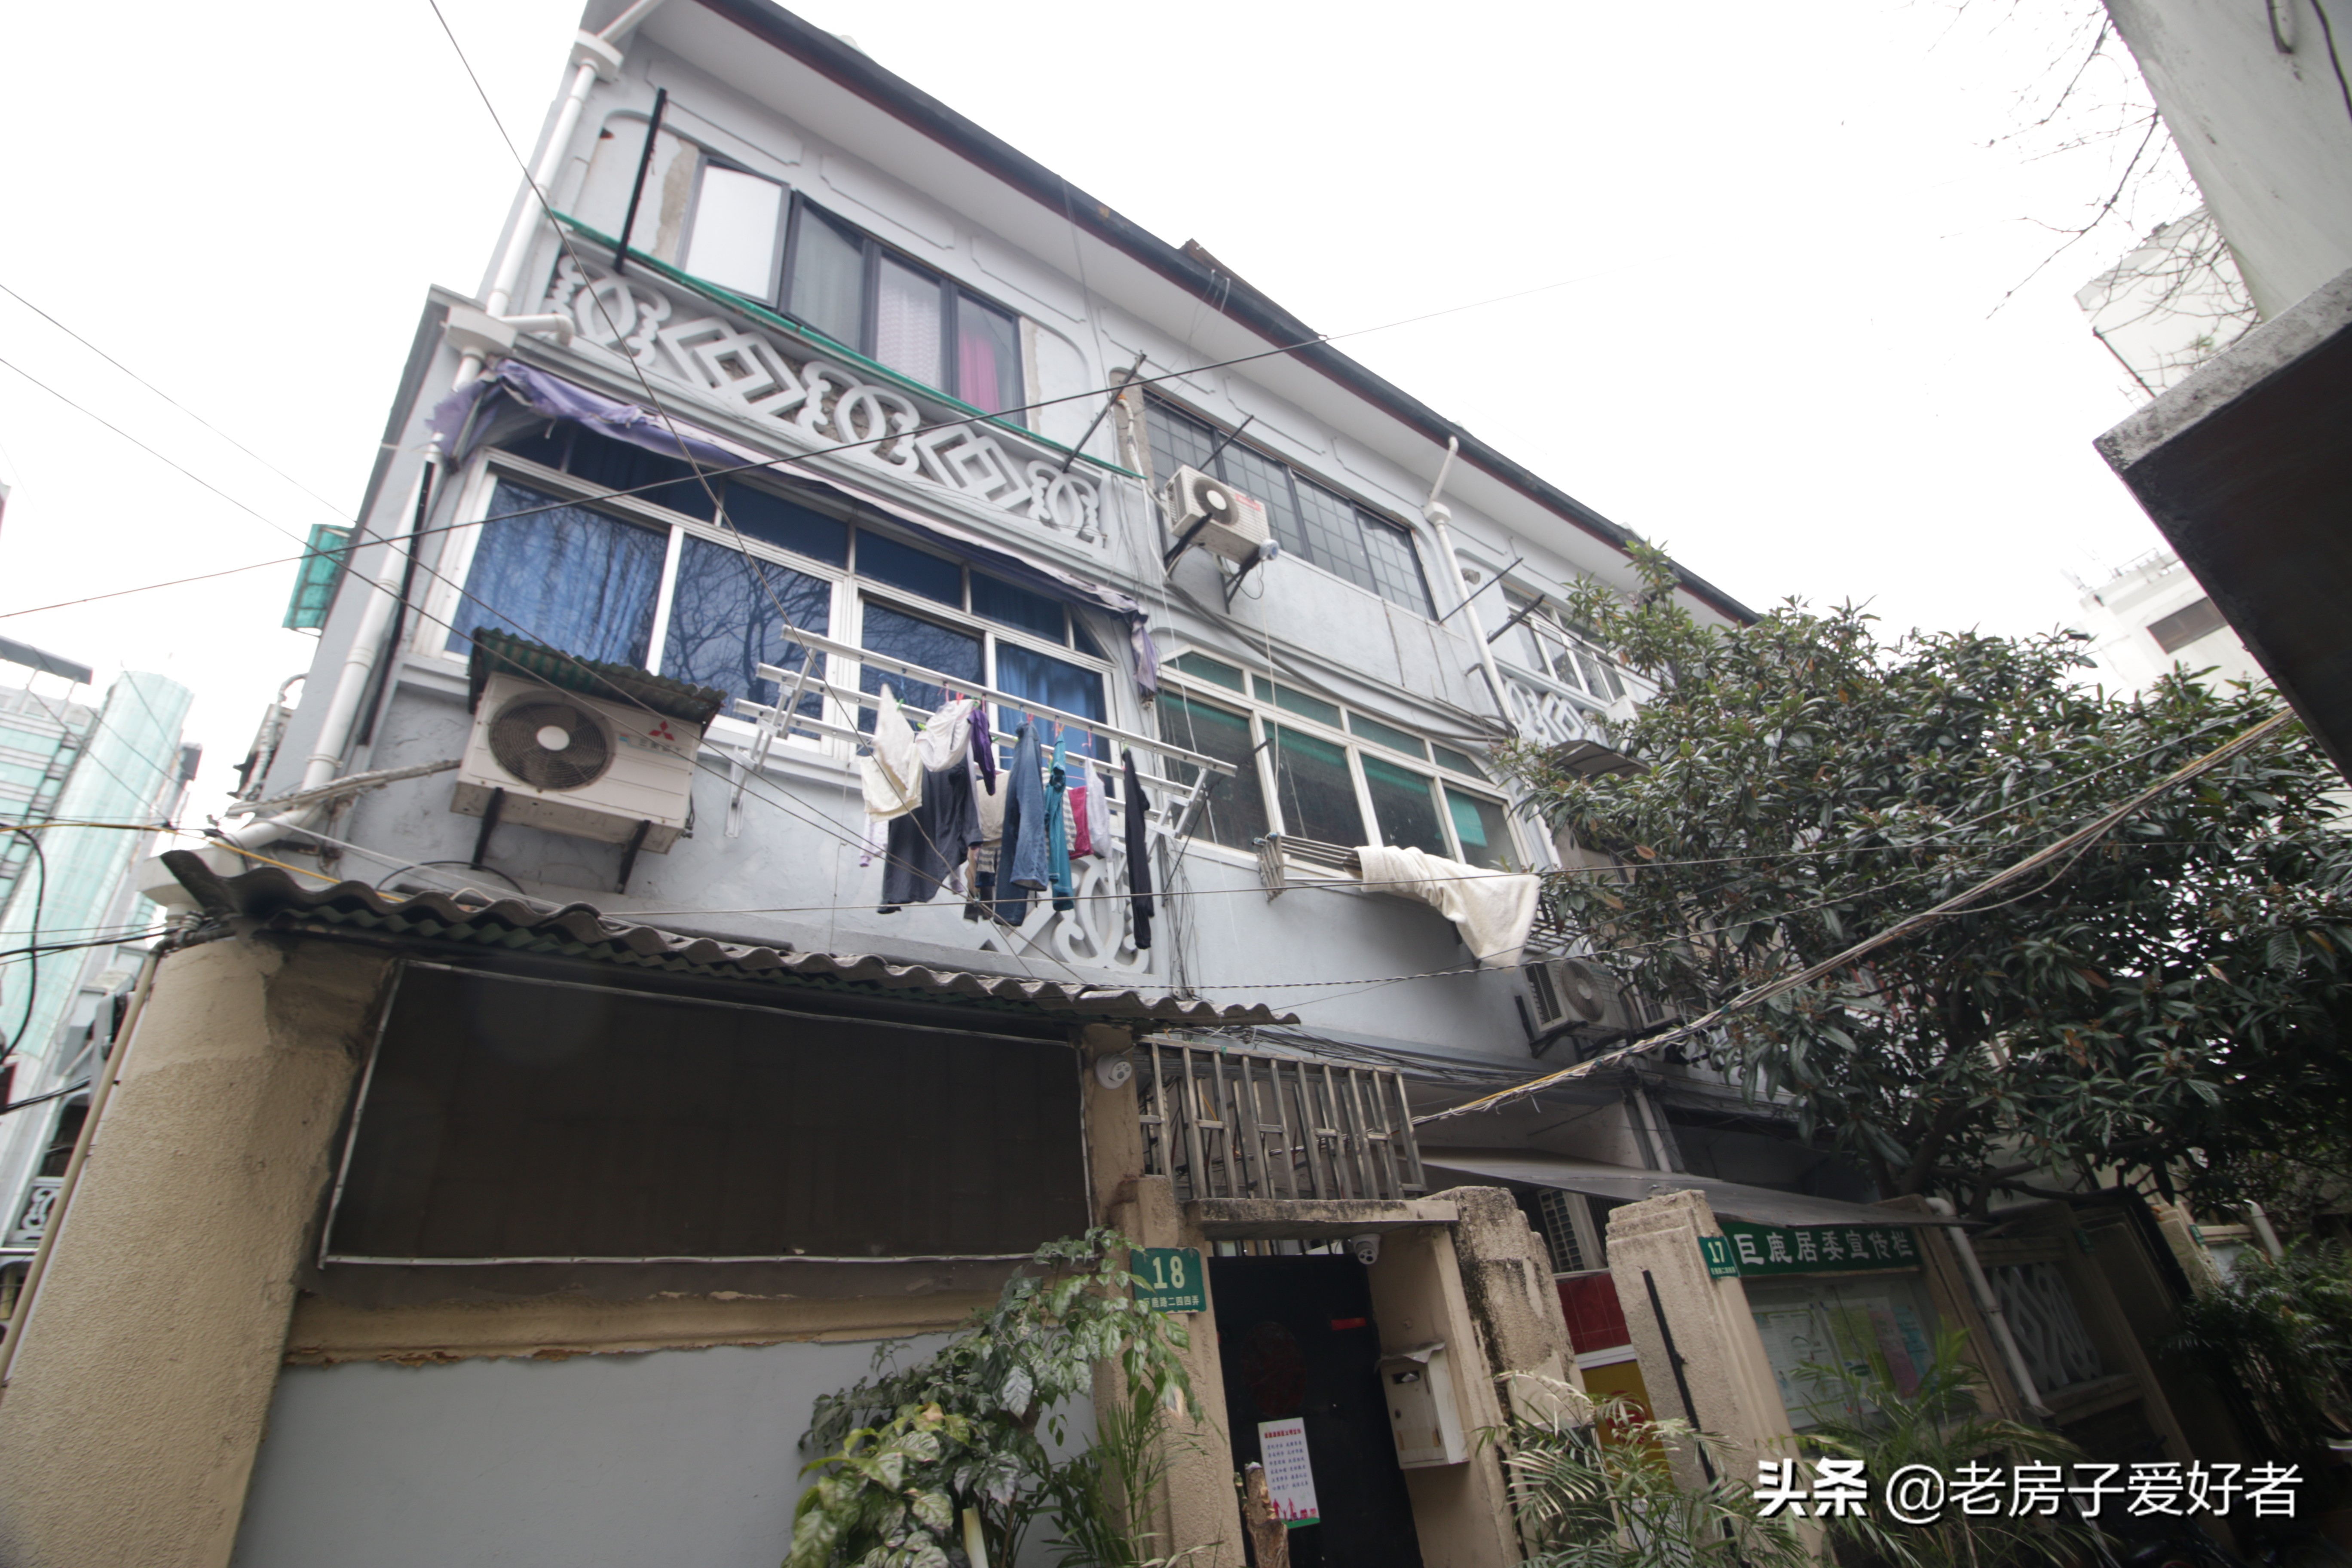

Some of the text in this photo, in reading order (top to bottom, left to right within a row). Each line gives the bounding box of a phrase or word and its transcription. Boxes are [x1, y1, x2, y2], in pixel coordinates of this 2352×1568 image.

[1708, 1241, 1725, 1263] 17
[1733, 1230, 1914, 1265] 巨鹿居委宣传栏
[1152, 1256, 1185, 1289] 18
